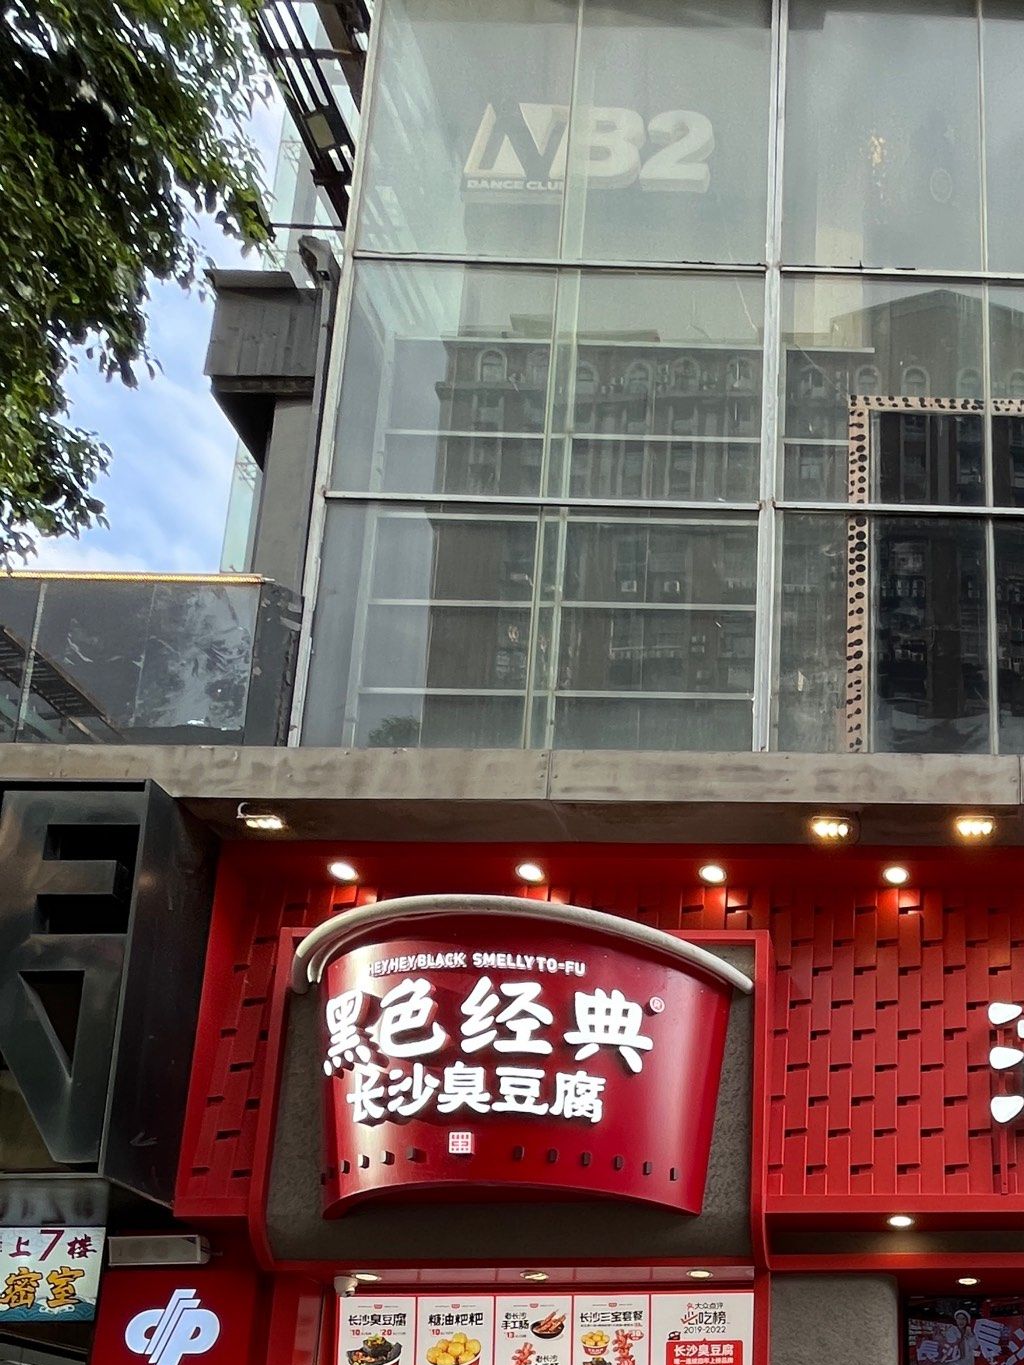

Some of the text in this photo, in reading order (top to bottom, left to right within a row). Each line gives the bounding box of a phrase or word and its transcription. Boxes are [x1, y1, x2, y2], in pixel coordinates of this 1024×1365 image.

[467, 179, 524, 191] DANCE
[417, 951, 466, 970] BLACK
[472, 952, 537, 972] SMELLY
[538, 956, 587, 977] TO-FU
[323, 975, 654, 1076] 黑色经典
[346, 1059, 607, 1123] 长沙臭豆腐
[0, 1229, 97, 1260] 上7楼
[0, 1266, 86, 1309] 密室
[348, 1312, 407, 1327] 长沙臭豆腐
[428, 1312, 484, 1327] 糖油粑粑
[579, 1310, 644, 1323] 长沙三宝套餐
[681, 1310, 727, 1326] 必吃榜
[500, 1320, 530, 1331] 手工肠
[683, 1326, 727, 1334] 2019-2022
[673, 1344, 735, 1358] 长沙臭豆腐
